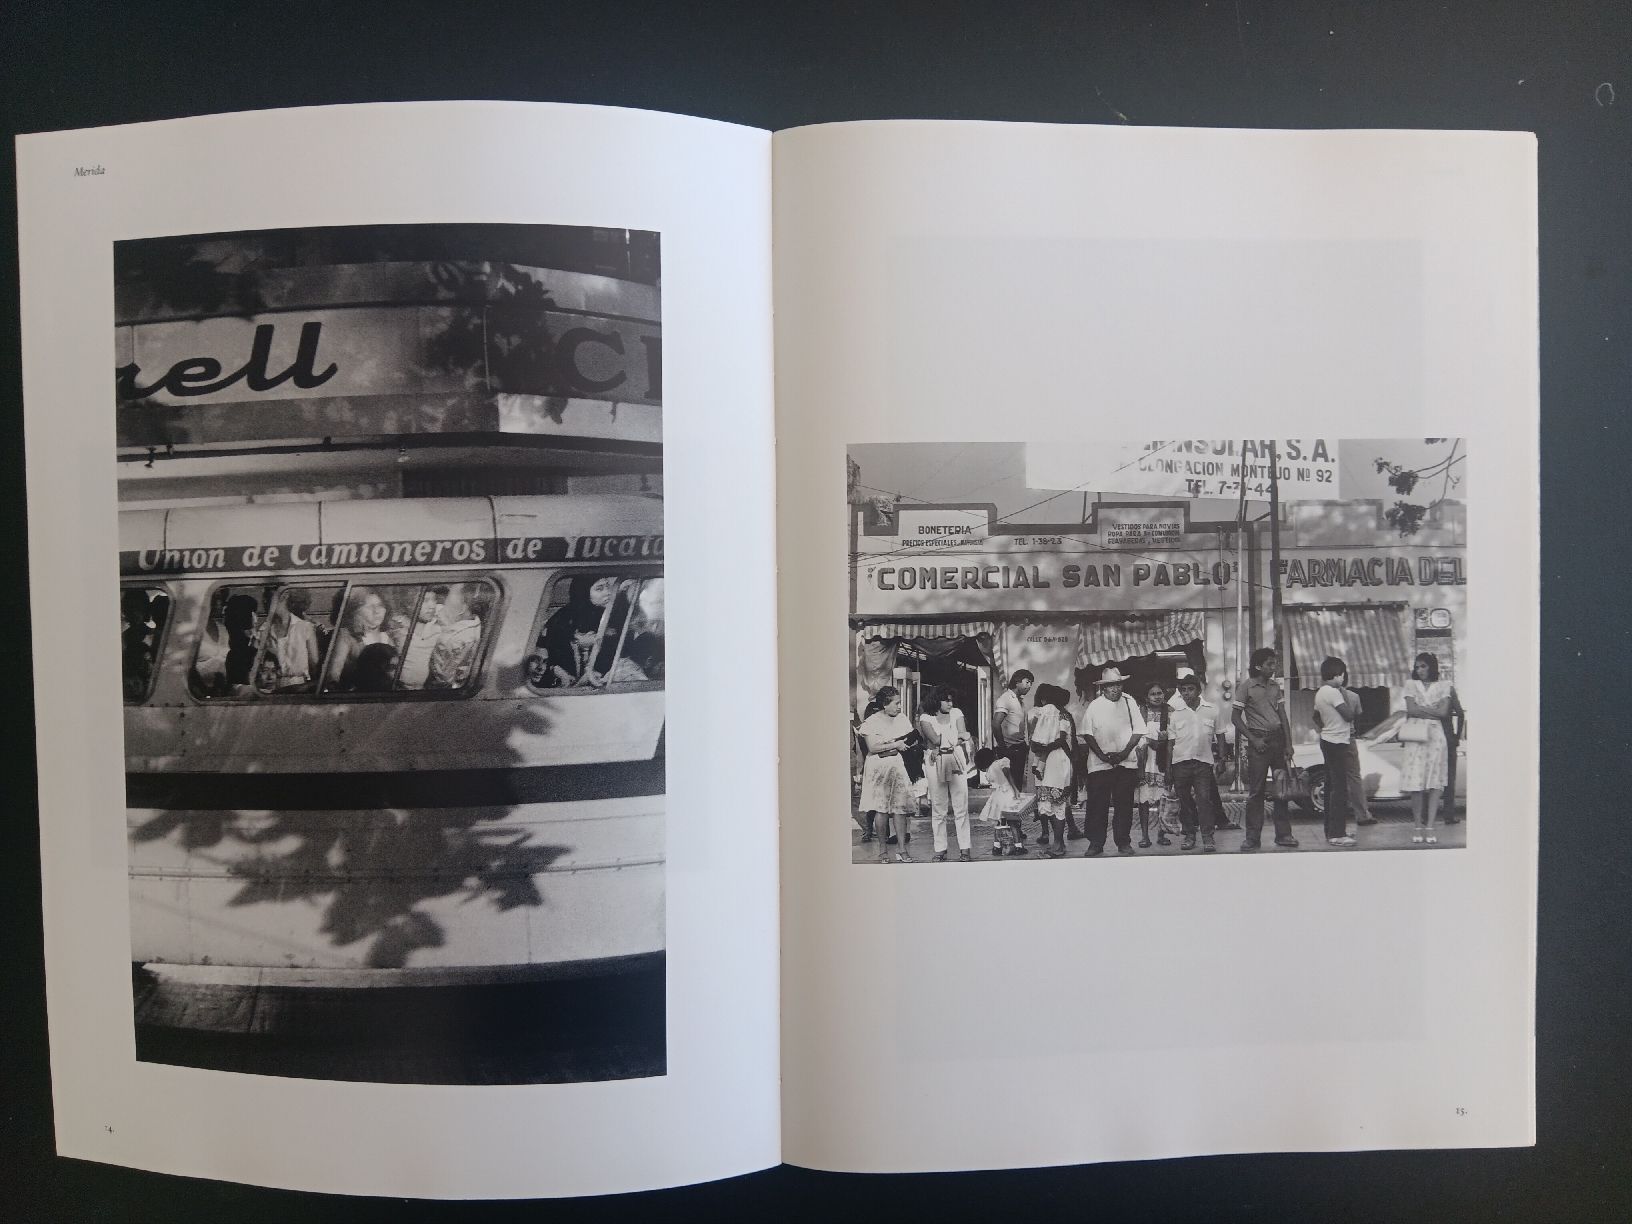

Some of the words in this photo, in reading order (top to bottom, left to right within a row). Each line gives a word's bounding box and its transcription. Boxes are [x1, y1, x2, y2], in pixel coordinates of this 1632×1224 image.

[1316, 469, 1333, 483] 92
[1014, 538, 1029, 546] TEL.
[241, 545, 280, 567] de
[290, 539, 486, 567] Camioneros
[506, 537, 543, 560] de
[1062, 563, 1121, 588] SAN
